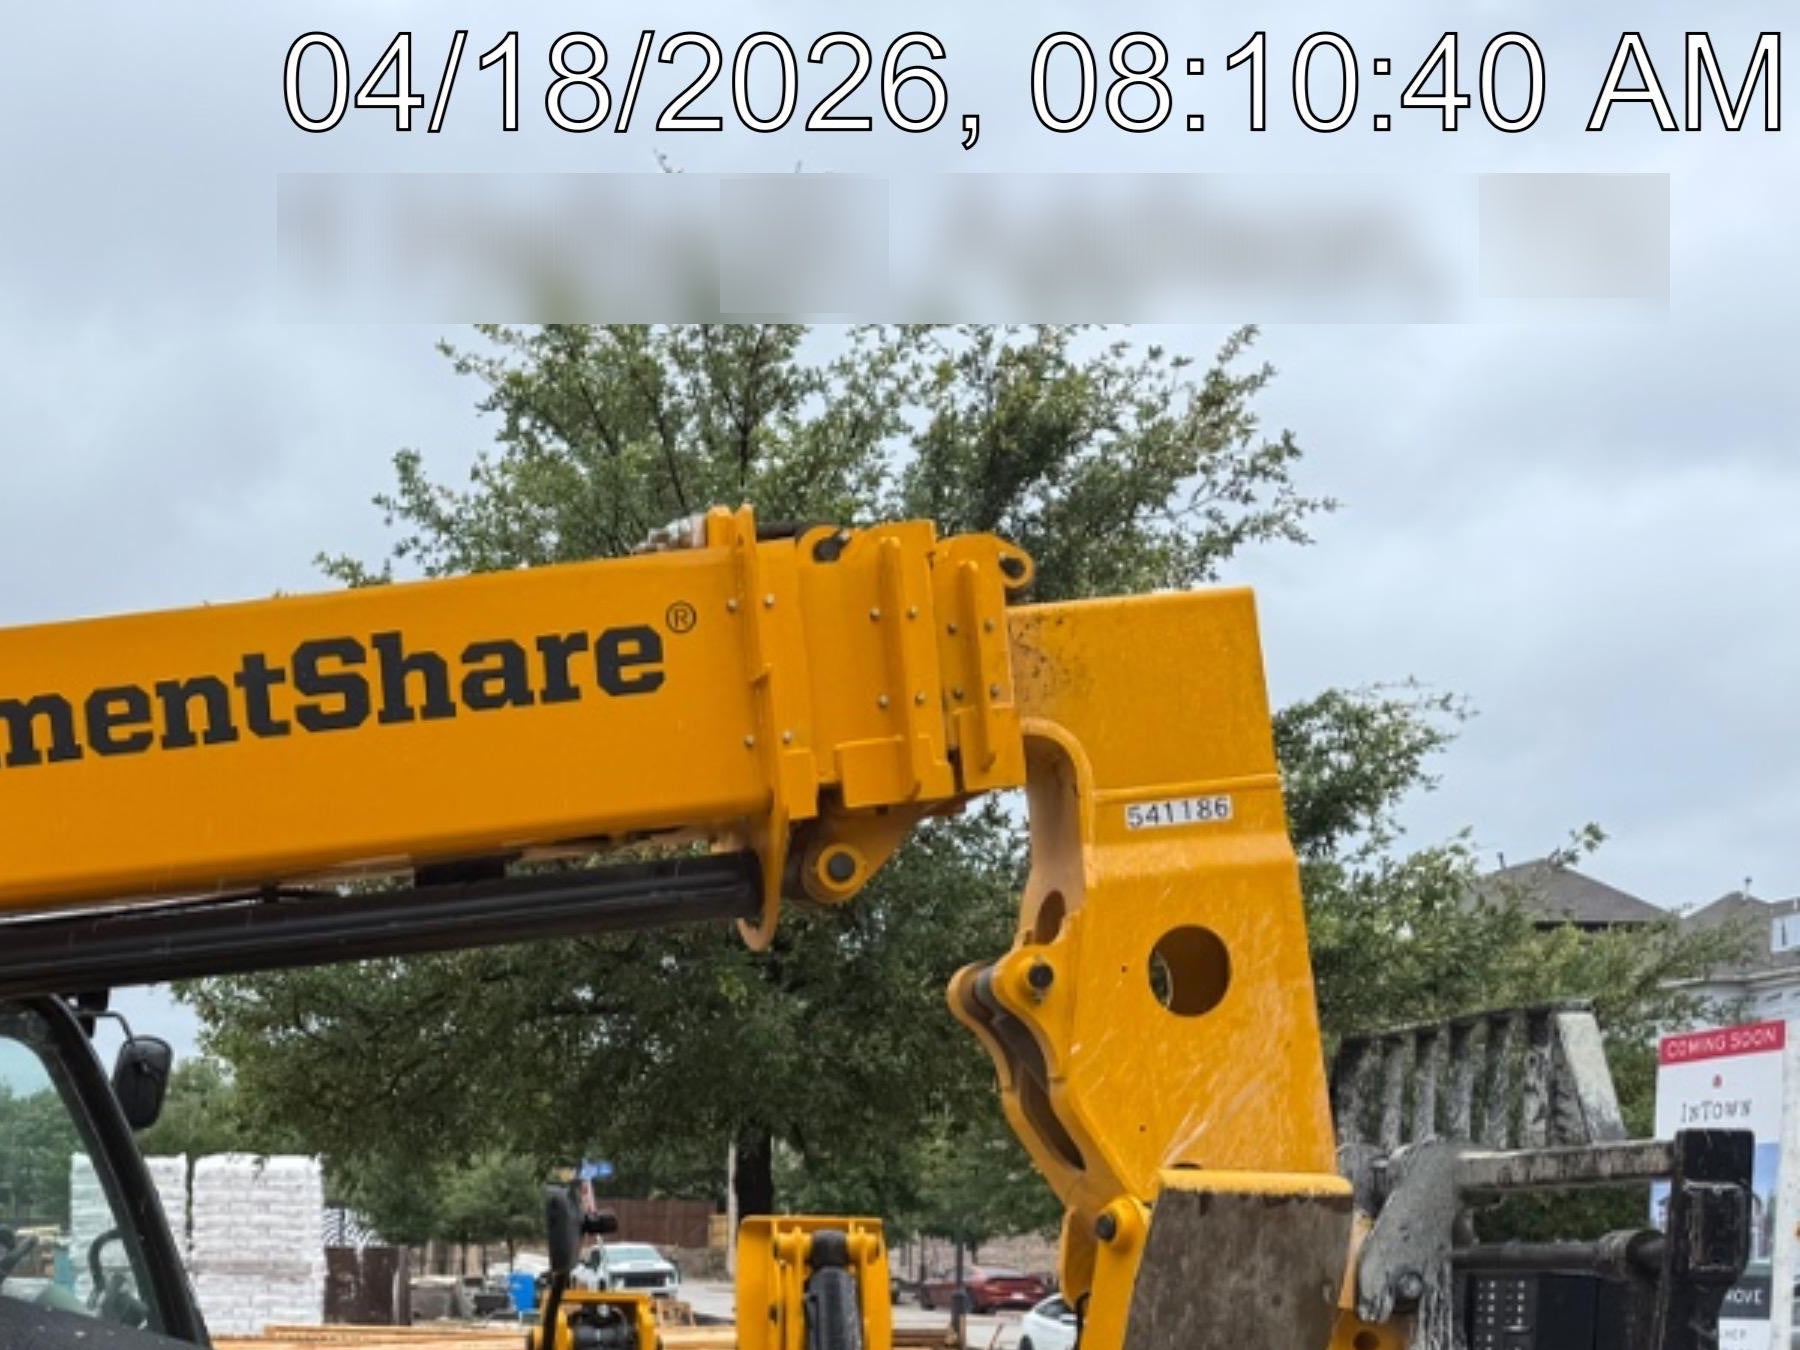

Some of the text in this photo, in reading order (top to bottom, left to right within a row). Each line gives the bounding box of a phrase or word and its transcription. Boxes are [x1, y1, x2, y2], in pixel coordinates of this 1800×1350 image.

[1128, 798, 1228, 828] 541186
[1666, 1026, 1778, 1059] COMING SOON
